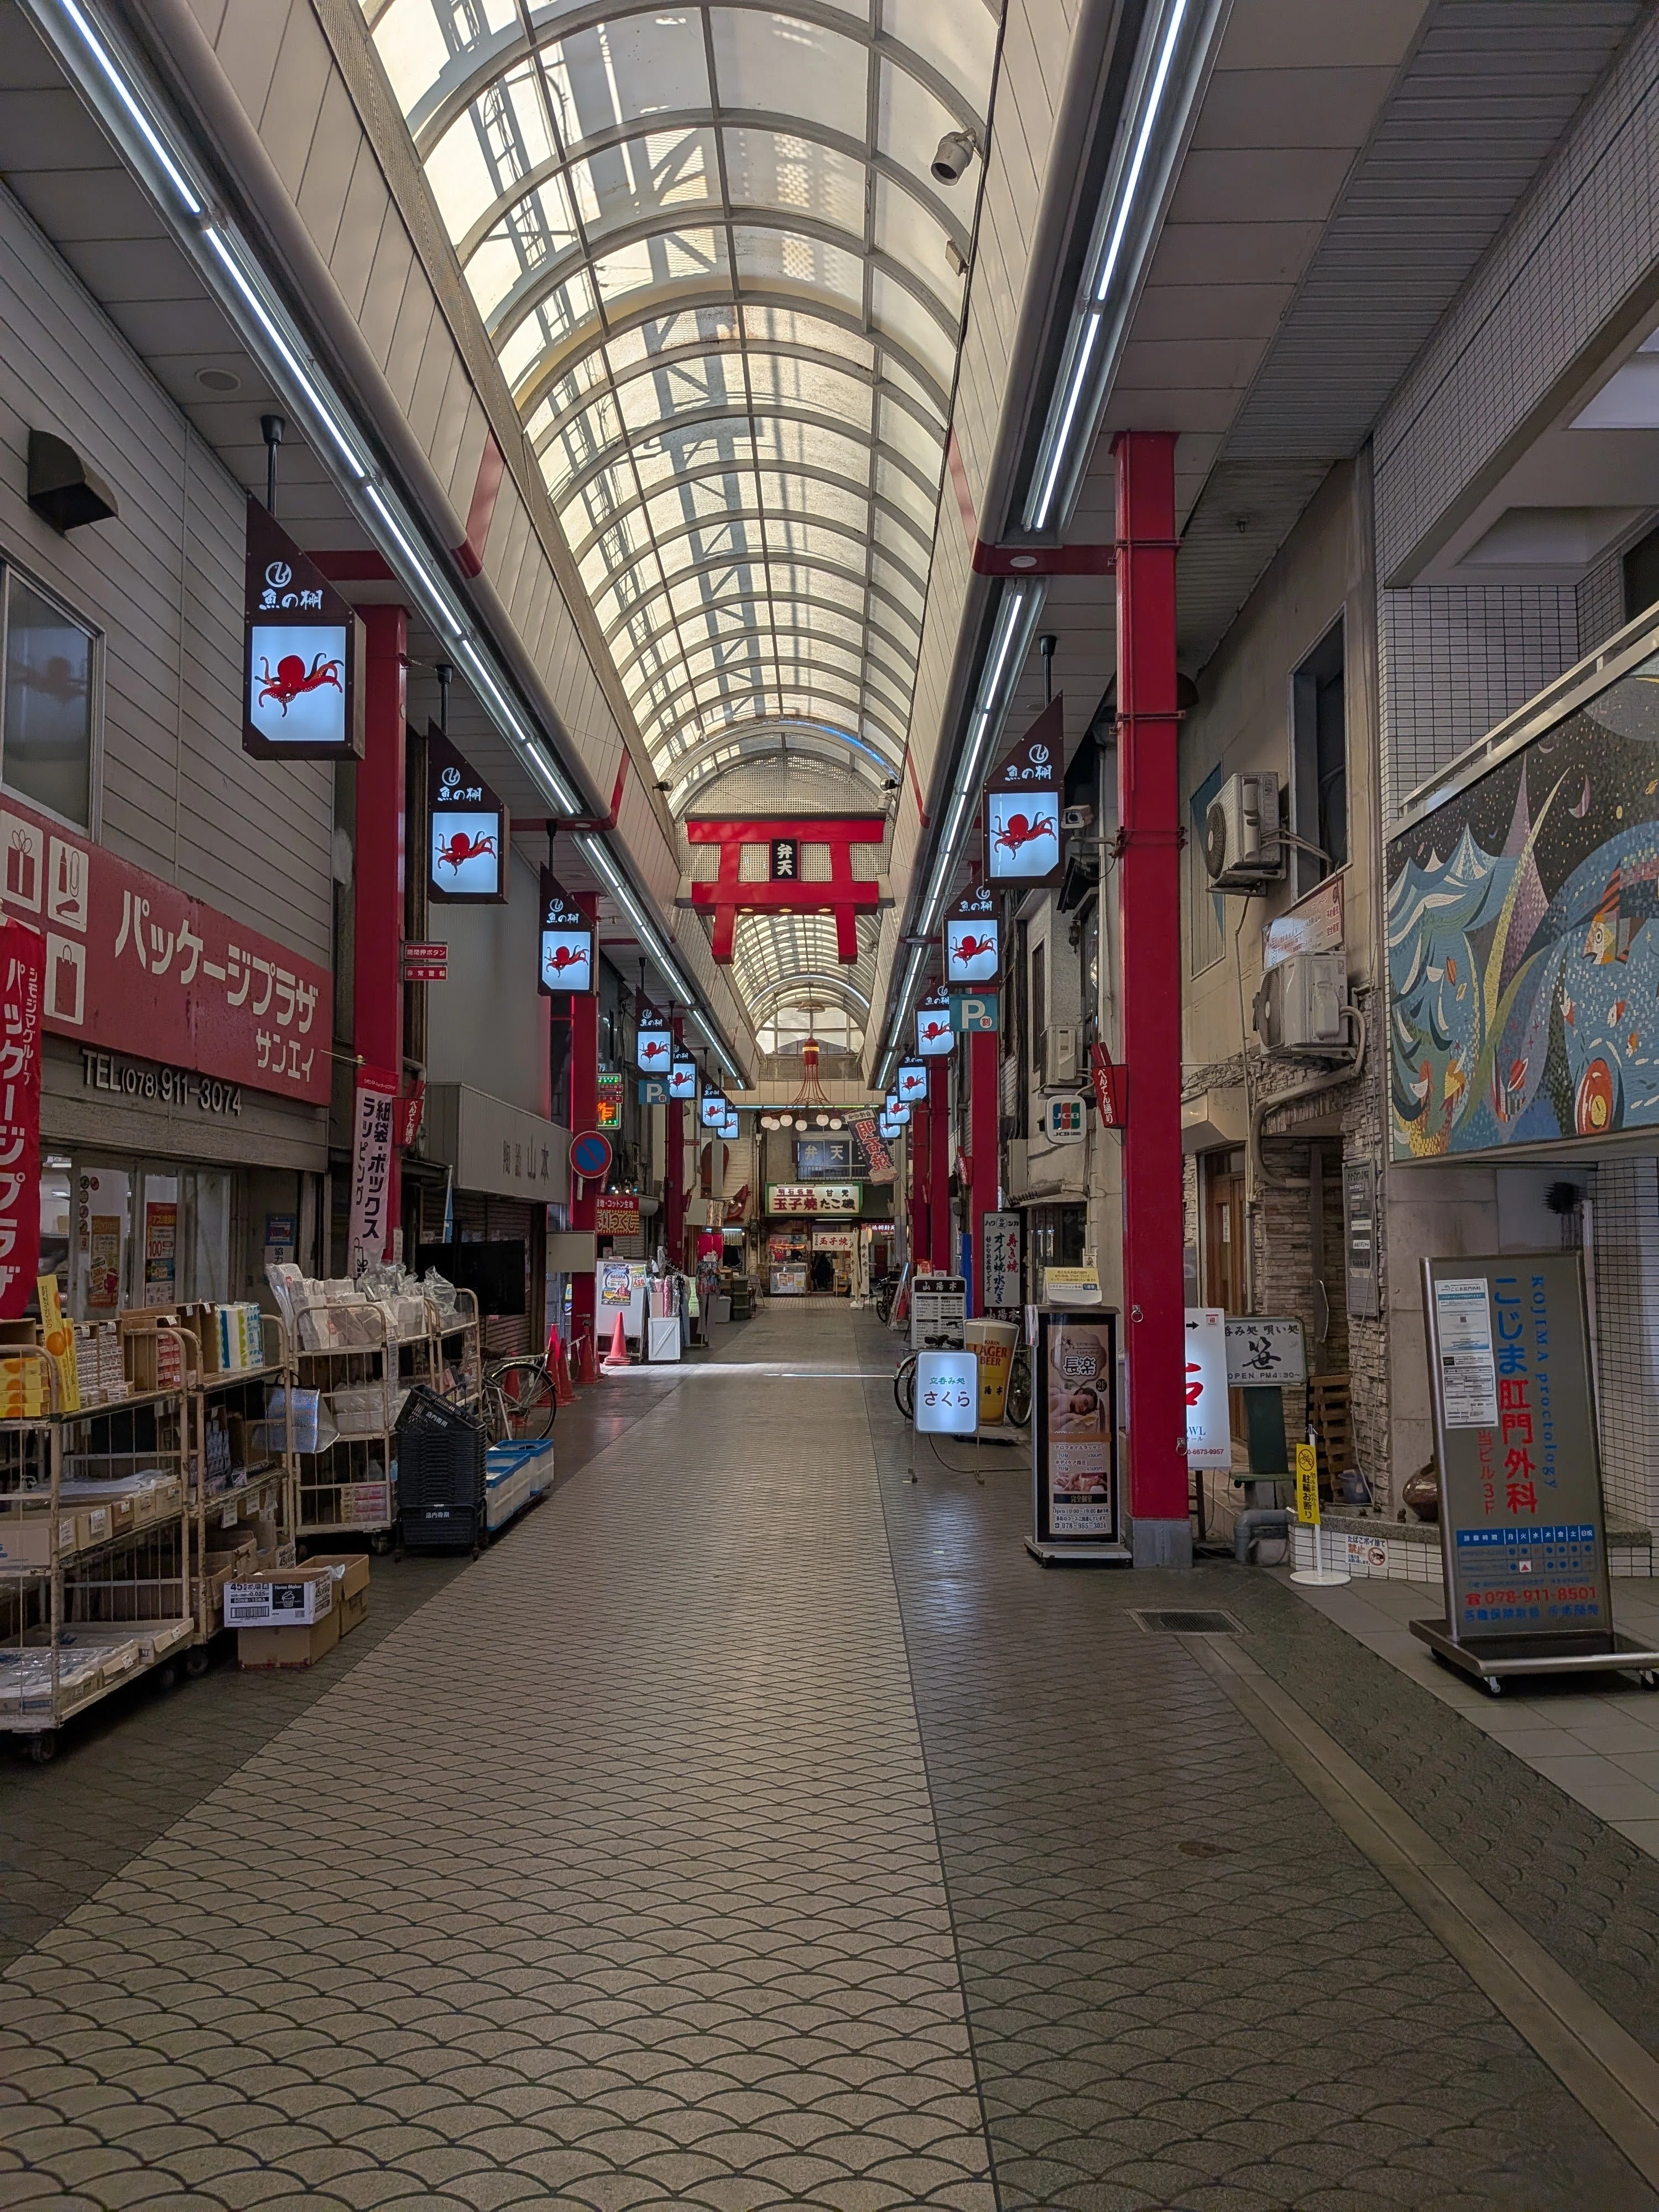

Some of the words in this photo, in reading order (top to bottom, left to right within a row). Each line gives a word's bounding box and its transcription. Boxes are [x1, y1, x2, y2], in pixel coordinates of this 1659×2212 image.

[259, 588, 323, 610] 魚の棚
[1004, 765, 1052, 781] 魚の棚
[437, 787, 482, 802] 魚の棚
[777, 843, 793, 875] 弁天
[959, 900, 993, 912] 魚の棚
[546, 913, 579, 924] 魚の棚
[115, 890, 319, 1034] パッケージプラザ
[640, 1019, 662, 1027] 魚の棚
[962, 999, 985, 1029] P
[23, 967, 38, 1086] シモジマグループ
[256, 1027, 314, 1082] サンエイ
[646, 1083, 662, 1103] P
[1098, 1068, 1113, 1124] べんてん通り
[404, 1100, 418, 1144] べんてん通り
[356, 1097, 375, 1206] ラッピング
[805, 1145, 844, 1160] 弁天
[362, 1099, 391, 1239] 紙袋・ボックス
[773, 1197, 818, 1211] 玉子焼
[820, 1198, 855, 1211] たこ磯
[820, 1237, 848, 1246] 玉子焼
[922, 1281, 957, 1291] 山陽亭
[1531, 1275, 1549, 1362] KOJIMA
[973, 1344, 1008, 1358] LAGER
[1243, 1337, 1282, 1370] 笹
[979, 1356, 1001, 1366] BEER
[1063, 1355, 1096, 1376] 長楽
[930, 1376, 966, 1385] 立呑み処
[924, 1391, 970, 1407] さくら
[1494, 1277, 1538, 1514] こじま肛門外科
[425, 1411, 448, 1428] 店内専用
[1187, 1426, 1206, 1436] WL
[1536, 1373, 1558, 1488] proctology
[1302, 1474, 1312, 1519] 駐輪お断り
[1348, 1535, 1386, 1547] たばこポイ捨て
[1485, 1586, 1597, 1605] 078-911-8501
